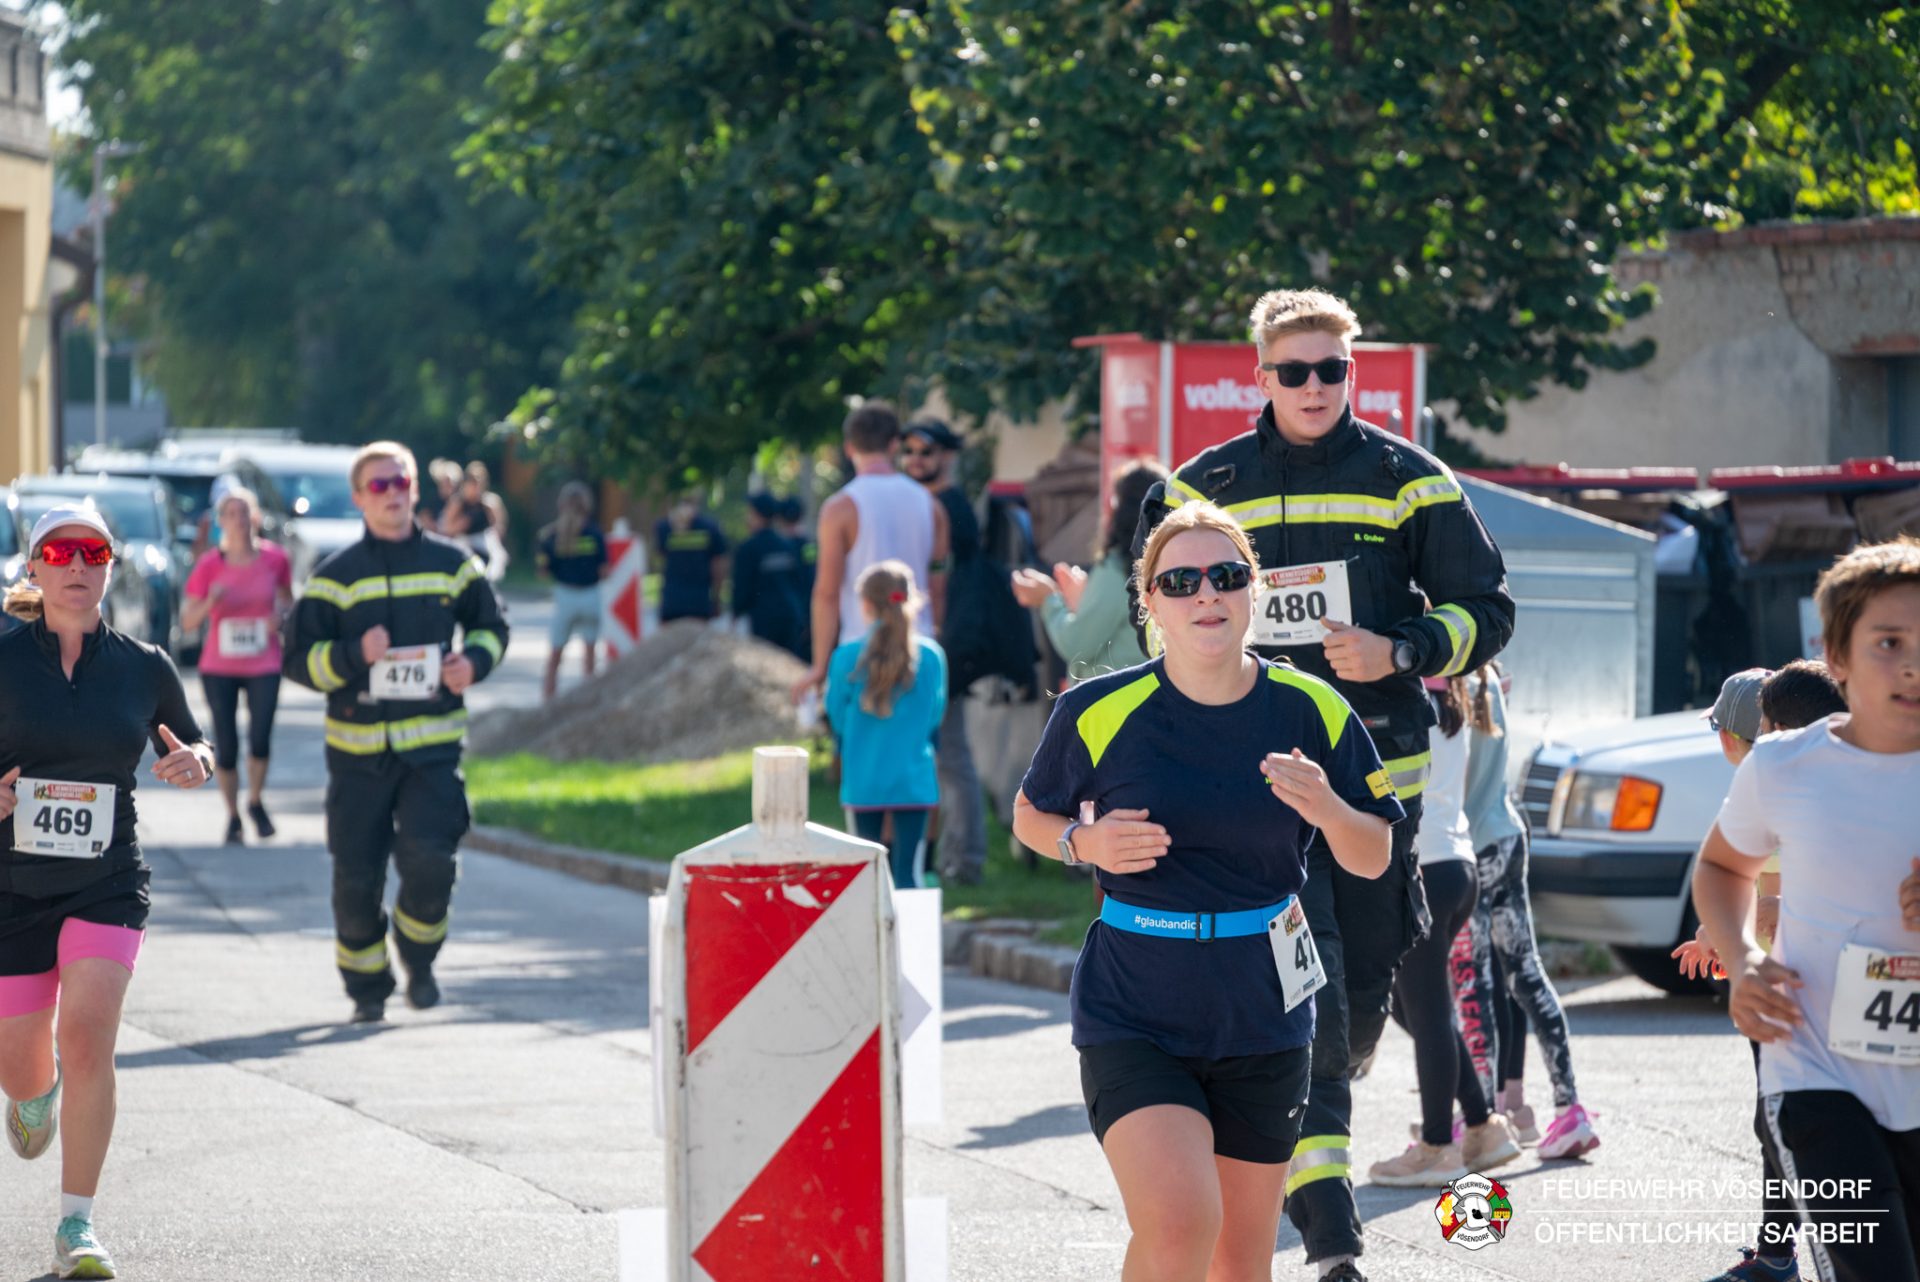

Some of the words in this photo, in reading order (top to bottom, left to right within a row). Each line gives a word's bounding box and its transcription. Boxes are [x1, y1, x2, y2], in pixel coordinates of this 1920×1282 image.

[1183, 379, 1262, 409] volks
[1358, 390, 1402, 411] BOX
[1265, 590, 1327, 624] 480
[385, 664, 426, 684] 476
[33, 805, 93, 836] 469
[1450, 920, 1477, 985] IRLS
[1864, 989, 1920, 1034] 44
